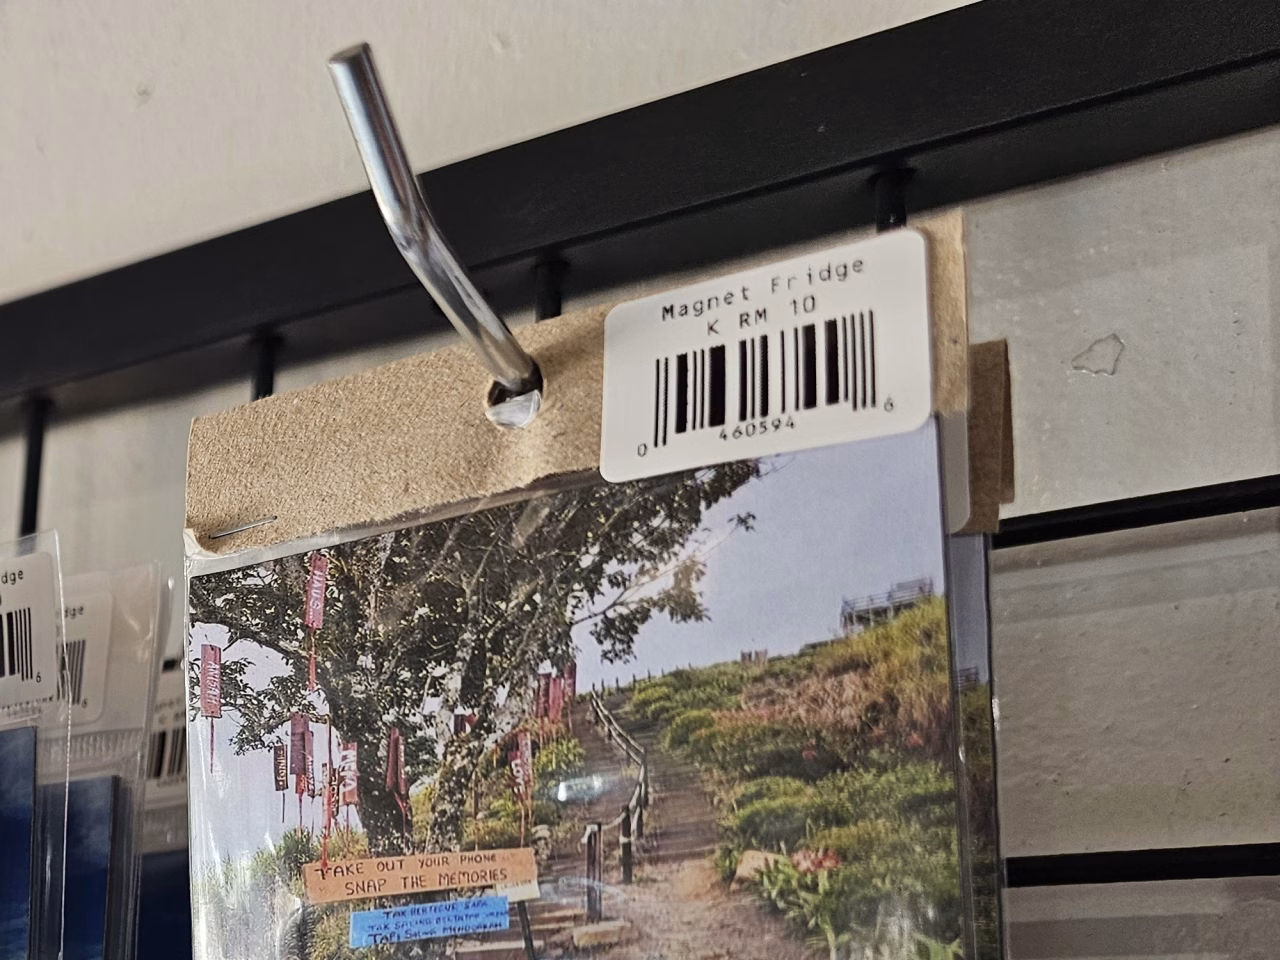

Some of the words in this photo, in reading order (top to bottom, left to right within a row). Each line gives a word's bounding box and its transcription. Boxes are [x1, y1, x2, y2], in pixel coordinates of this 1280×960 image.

[661, 285, 751, 322] Magnet
[770, 258, 865, 296] Fridge
[706, 319, 720, 336] K
[738, 307, 769, 329] RM
[789, 295, 818, 316] 10
[636, 442, 649, 458] 0
[718, 415, 796, 441] 460594
[883, 393, 895, 412] 6
[314, 861, 364, 882] TAKE
[376, 859, 405, 873] OUT
[418, 855, 450, 869] YOUR
[459, 852, 497, 867] PHONE
[344, 877, 387, 897] SNAP
[401, 874, 428, 890] THE
[438, 867, 508, 886] MEMORIES
